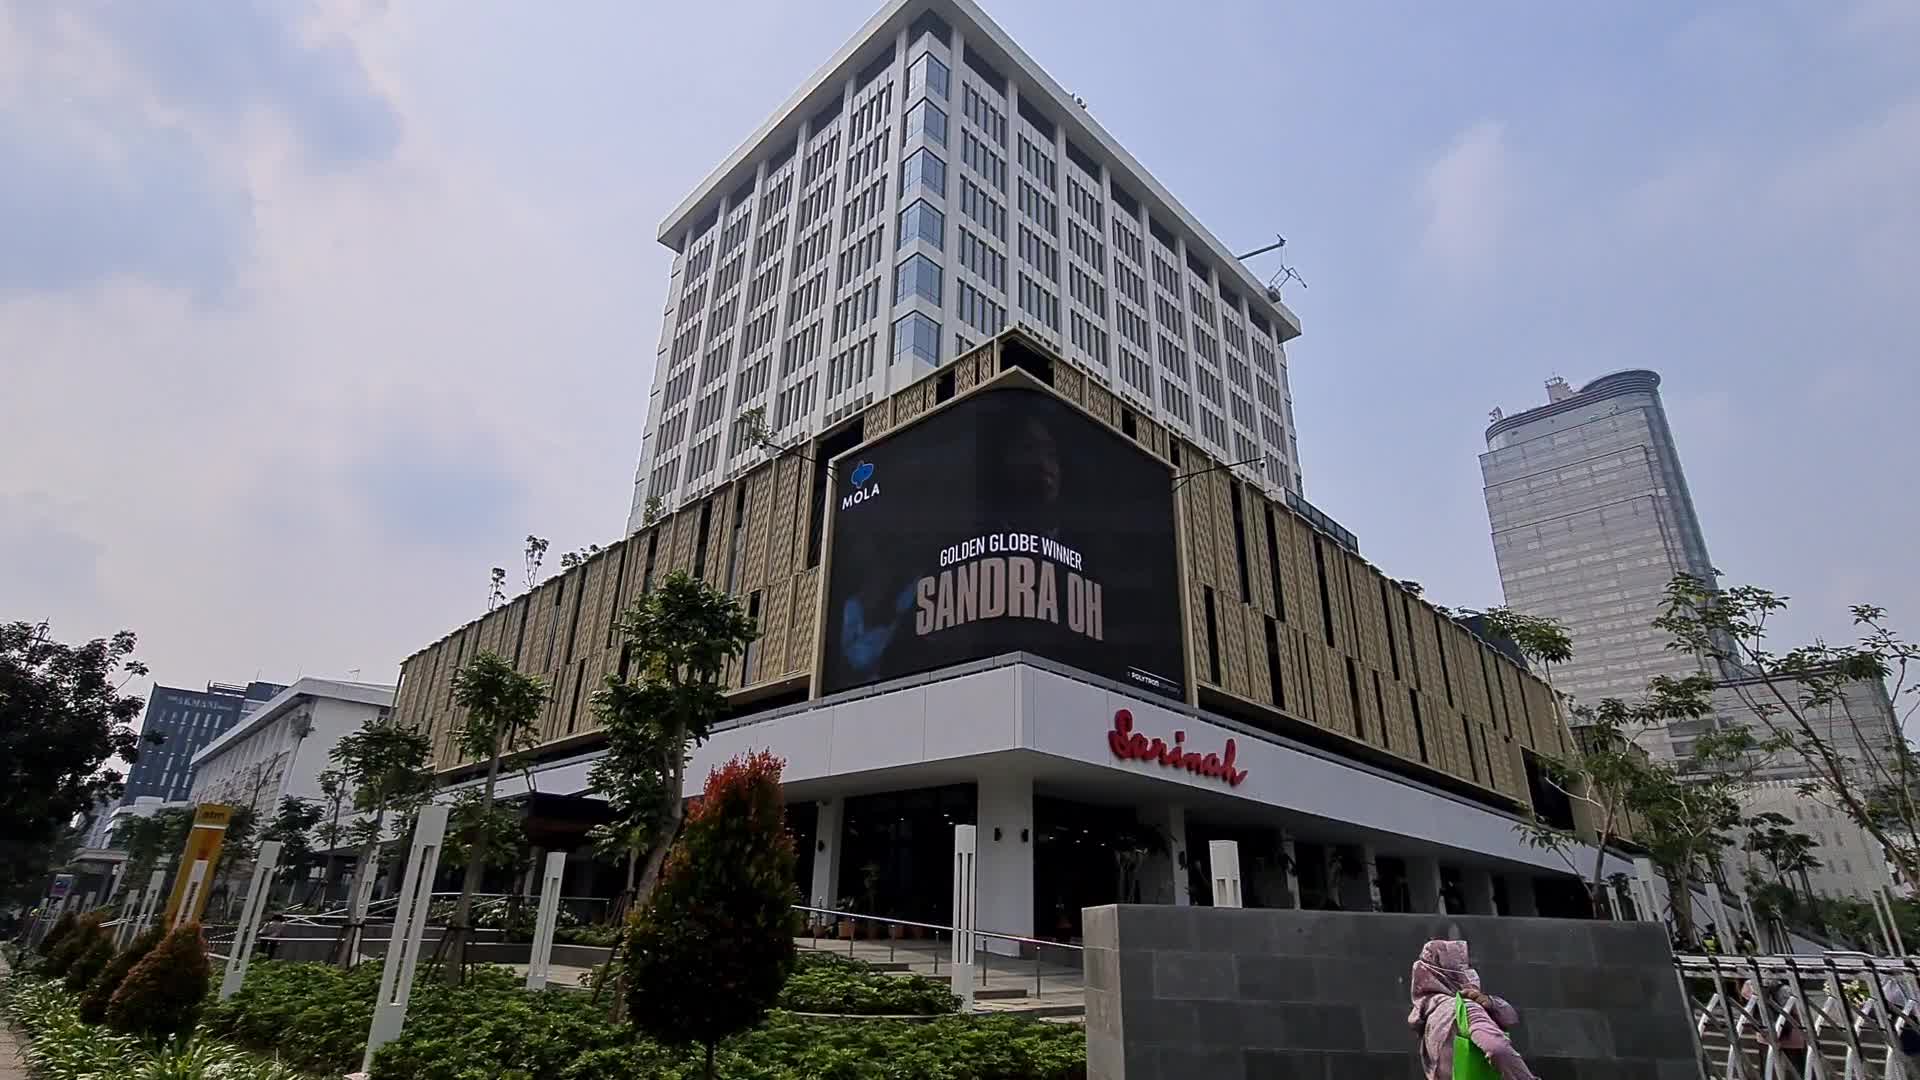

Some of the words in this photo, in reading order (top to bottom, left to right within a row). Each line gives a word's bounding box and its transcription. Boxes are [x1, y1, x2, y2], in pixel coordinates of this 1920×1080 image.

[842, 483, 880, 510] MOLA
[940, 536, 985, 567] GOLDEN
[989, 533, 1038, 553] GLOBE
[1042, 537, 1082, 571] WINNER
[916, 557, 1059, 635] SANDRA
[1067, 572, 1103, 641] OH
[1108, 709, 1248, 786] Sarinah
